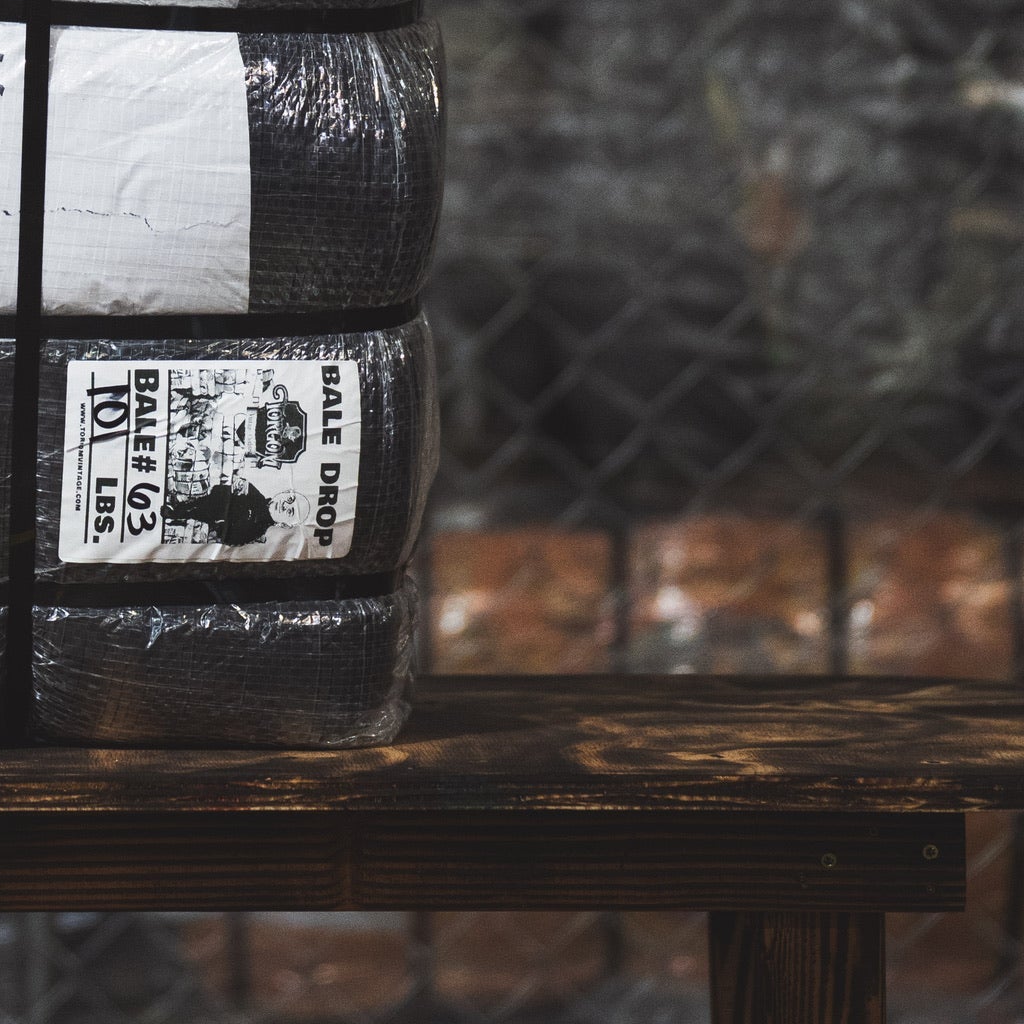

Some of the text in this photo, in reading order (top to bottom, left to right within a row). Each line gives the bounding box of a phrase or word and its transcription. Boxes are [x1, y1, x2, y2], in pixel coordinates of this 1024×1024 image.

[257, 384, 289, 469] TORGOM
[314, 365, 342, 547] BALE DROP
[92, 477, 118, 544] LBS.
[127, 483, 160, 536] 63
